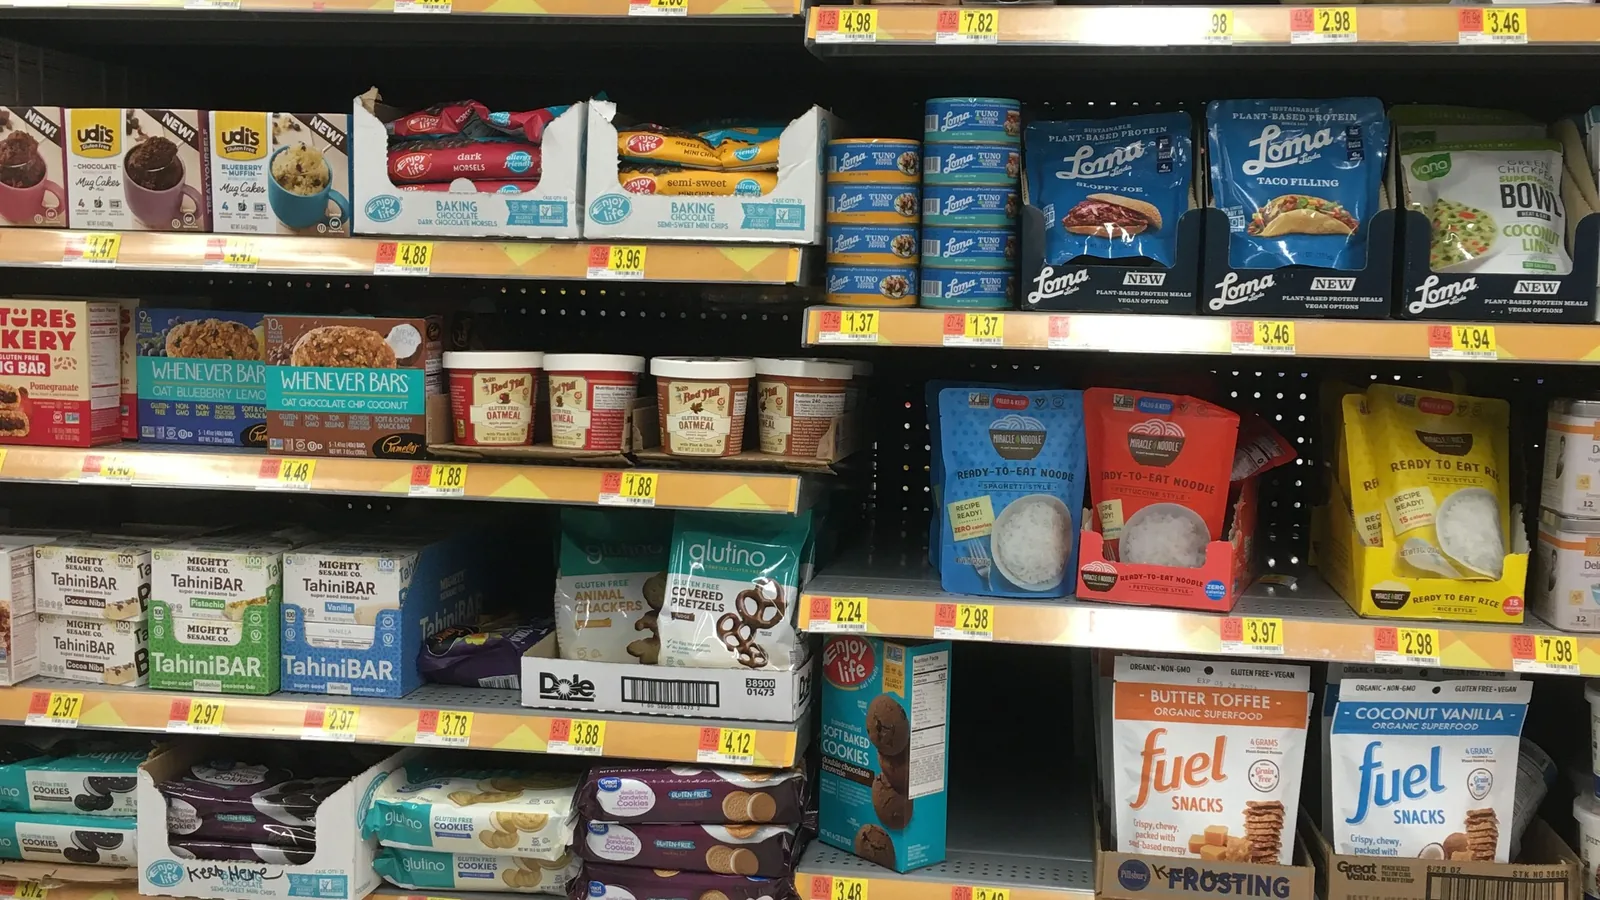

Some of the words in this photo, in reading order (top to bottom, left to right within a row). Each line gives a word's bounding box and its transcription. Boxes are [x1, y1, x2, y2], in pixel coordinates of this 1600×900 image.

[1233, 113, 1306, 121] PLANT-BASED
[1309, 113, 1357, 121] PROTEIN
[77, 124, 114, 143] udi's
[161, 112, 195, 142] NEW!
[309, 116, 344, 146] NEW!
[221, 126, 260, 146] udi's
[1049, 131, 1119, 142] PLANT-BASED
[1121, 126, 1167, 137] PROTEIN
[1242, 124, 1334, 175] Loma
[457, 152, 482, 161] dark
[839, 152, 867, 172] Loma
[1055, 140, 1145, 180] Loma
[453, 164, 485, 172] MORSELS
[75, 177, 95, 191] Mug
[95, 175, 121, 187] Cakes
[667, 178, 727, 188] semi-sweet
[1075, 181, 1120, 191] SLOPPY
[1257, 177, 1288, 186] TACO
[1290, 178, 1339, 187] FILLING
[436, 200, 478, 211] BAKING
[1500, 182, 1562, 218] BOWL
[671, 202, 715, 214] BAKING
[436, 212, 478, 220] CHOCOLATE
[671, 214, 715, 222] CHOCOLATE
[1503, 224, 1560, 245] COCONUT
[1521, 239, 1552, 255] LIME
[1028, 266, 1089, 304] Loma
[1128, 274, 1163, 284] NEW
[1314, 279, 1353, 289] NEW
[1209, 272, 1275, 311] Loma
[1409, 275, 1477, 314] Loma
[1518, 283, 1557, 293] NEW
[18, 362, 46, 374] BAR
[152, 361, 233, 382] WHENEVER
[237, 364, 266, 384] BAR
[29, 381, 79, 392] Pomegranate
[281, 370, 366, 392] WHENEVER
[370, 373, 409, 393] BARS
[152, 386, 172, 396] OAT
[176, 387, 232, 398] BLUEBERRY
[236, 389, 266, 400] LEMO
[282, 398, 297, 406] OAT
[299, 399, 346, 408] CHOCOLATE
[347, 400, 366, 409] CHIP
[367, 401, 408, 410] COCONUT
[486, 411, 521, 420] OATMEAL
[678, 421, 714, 431] OATMEAL
[993, 435, 1015, 444] MIRACLE
[1020, 435, 1042, 445] NOODLE
[957, 467, 1037, 480] READY-TO-EAT
[1040, 469, 1074, 483] NOODLE
[955, 501, 980, 512] RECIPE
[956, 510, 983, 520] READY!
[954, 525, 971, 534] ZERO
[972, 522, 993, 530] calories
[65, 555, 103, 566] MIGHTY
[689, 539, 766, 570] glutino
[187, 557, 230, 567] MIGHTY
[319, 560, 362, 571] MIGHTY
[51, 572, 117, 591] TahiniBAR
[171, 574, 243, 592] TahiniBAR
[302, 578, 376, 595] TahiniBAR
[575, 581, 606, 589] GLUTEN
[608, 579, 629, 587] FREE
[1120, 574, 1174, 582] READY-TO-EAT
[1176, 575, 1204, 588] NOODLE
[575, 589, 625, 601] ANIMAL
[671, 586, 724, 601] COVERED
[65, 596, 88, 606] Cocoa
[88, 598, 106, 607] Nibs
[190, 599, 225, 609] Pistachio
[575, 601, 643, 614] CRACKERS
[670, 597, 725, 613] PRETZELS
[1412, 595, 1442, 605] READY
[1458, 594, 1476, 603] EAT
[1478, 596, 1500, 608] RICE
[326, 604, 352, 613] Vanilla
[151, 652, 261, 677] TahiniBAR
[282, 654, 394, 681] TahiniBAR
[1130, 663, 1156, 672] ORGANIC
[1160, 666, 1191, 674] NON-GMO
[838, 660, 866, 683] life
[539, 672, 595, 697] Dole
[746, 679, 775, 688] 38900
[1356, 684, 1382, 693] ORGANIC
[1387, 684, 1416, 693] NON-GMO
[746, 688, 775, 696] 01473
[1151, 690, 1206, 706] BUTTER
[1212, 692, 1271, 710] TOFFEE
[1154, 707, 1202, 718] ORGANIC
[1204, 709, 1264, 721] SUPERFOOD
[1355, 707, 1438, 721] COCONUT
[1441, 708, 1504, 722] VANILLA
[1372, 722, 1420, 730] ORGANIC
[1421, 722, 1479, 731] SUPERFOOD
[823, 724, 843, 741] SOFT
[843, 730, 870, 749] BAKED
[822, 740, 870, 766] COOKIES
[1129, 727, 1228, 809] fuel
[1345, 741, 1448, 826] fuel
[33, 786, 70, 795] COOKIES
[1172, 795, 1224, 814] SNACKS
[1393, 809, 1446, 825] SNACKS
[433, 822, 474, 832] COOKIES
[22, 838, 58, 848] COOKIES
[1350, 834, 1376, 847] Crispy,
[1376, 836, 1402, 847] chewy,
[1354, 846, 1380, 856] packed
[1381, 847, 1398, 856] with
[402, 857, 446, 872] glutino
[457, 862, 498, 871] COOKIES
[1120, 868, 1148, 881] Pillsbury
[1169, 866, 1290, 899] FROSTING
